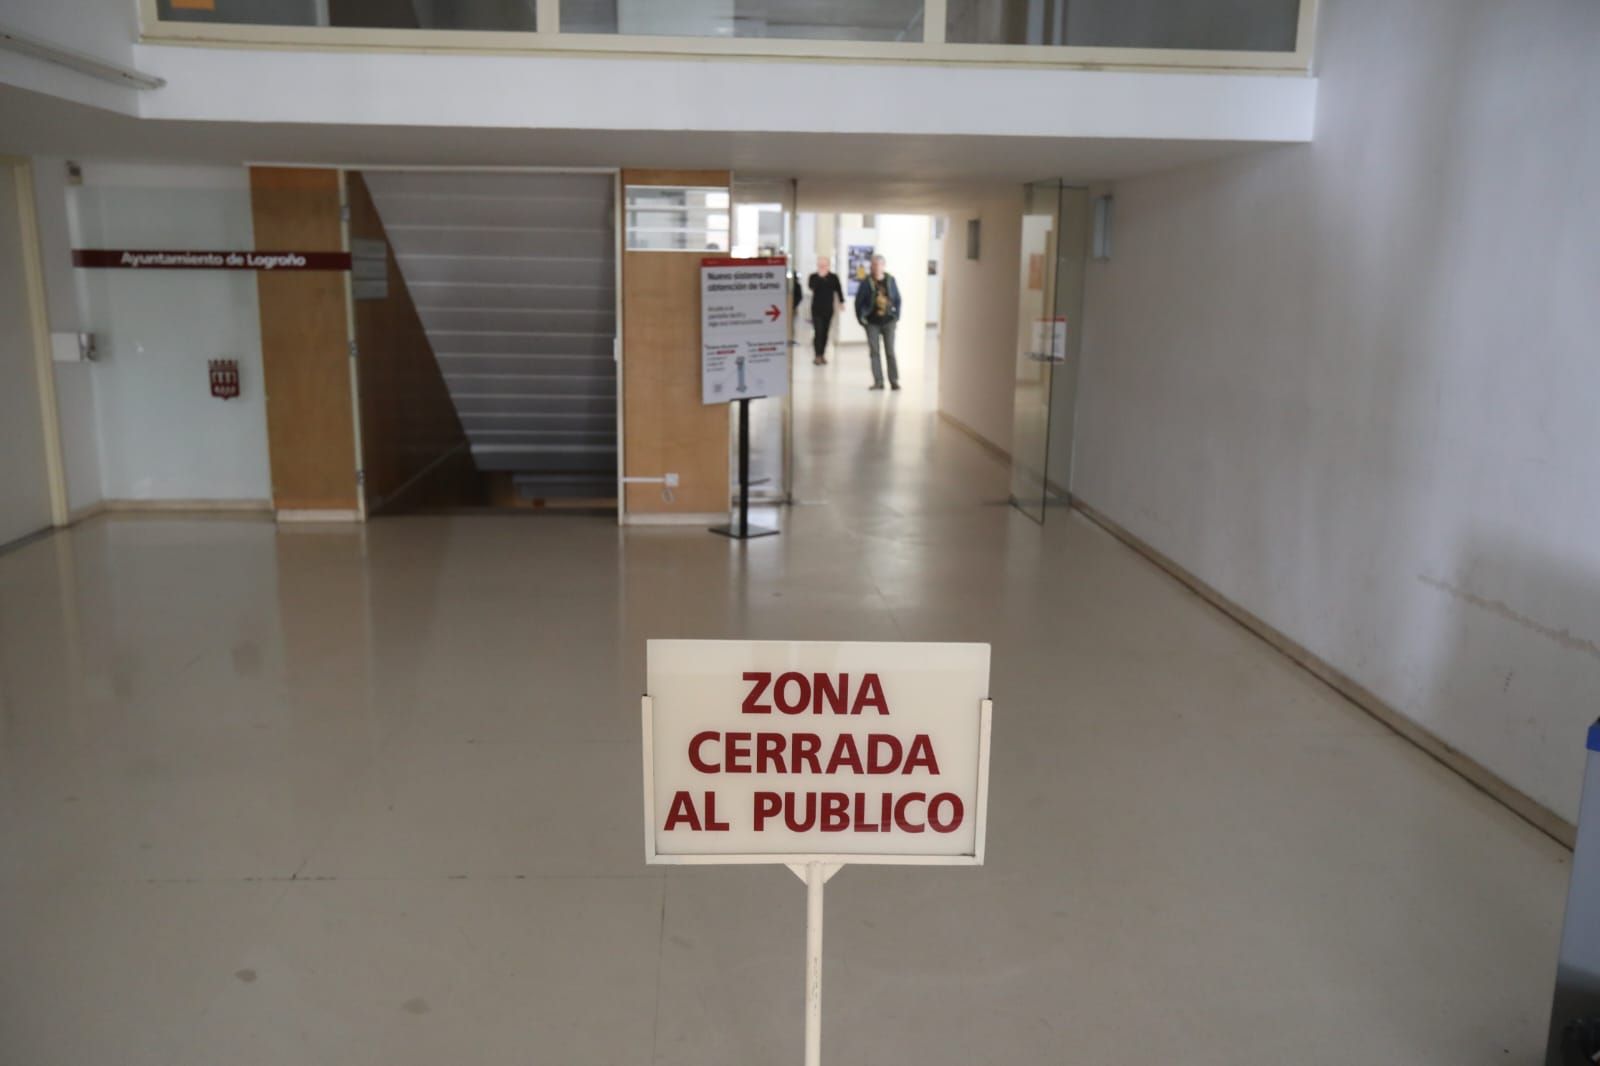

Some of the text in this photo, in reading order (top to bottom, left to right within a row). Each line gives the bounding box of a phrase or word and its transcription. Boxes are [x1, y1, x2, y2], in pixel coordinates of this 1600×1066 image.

[121, 252, 306, 269] Ayuntamiento de Logroño
[707, 271, 775, 280] Nuevo sistema de
[741, 671, 890, 715] ZONA
[688, 731, 940, 775] CERRADA
[663, 791, 964, 833] AL PUBLICO
